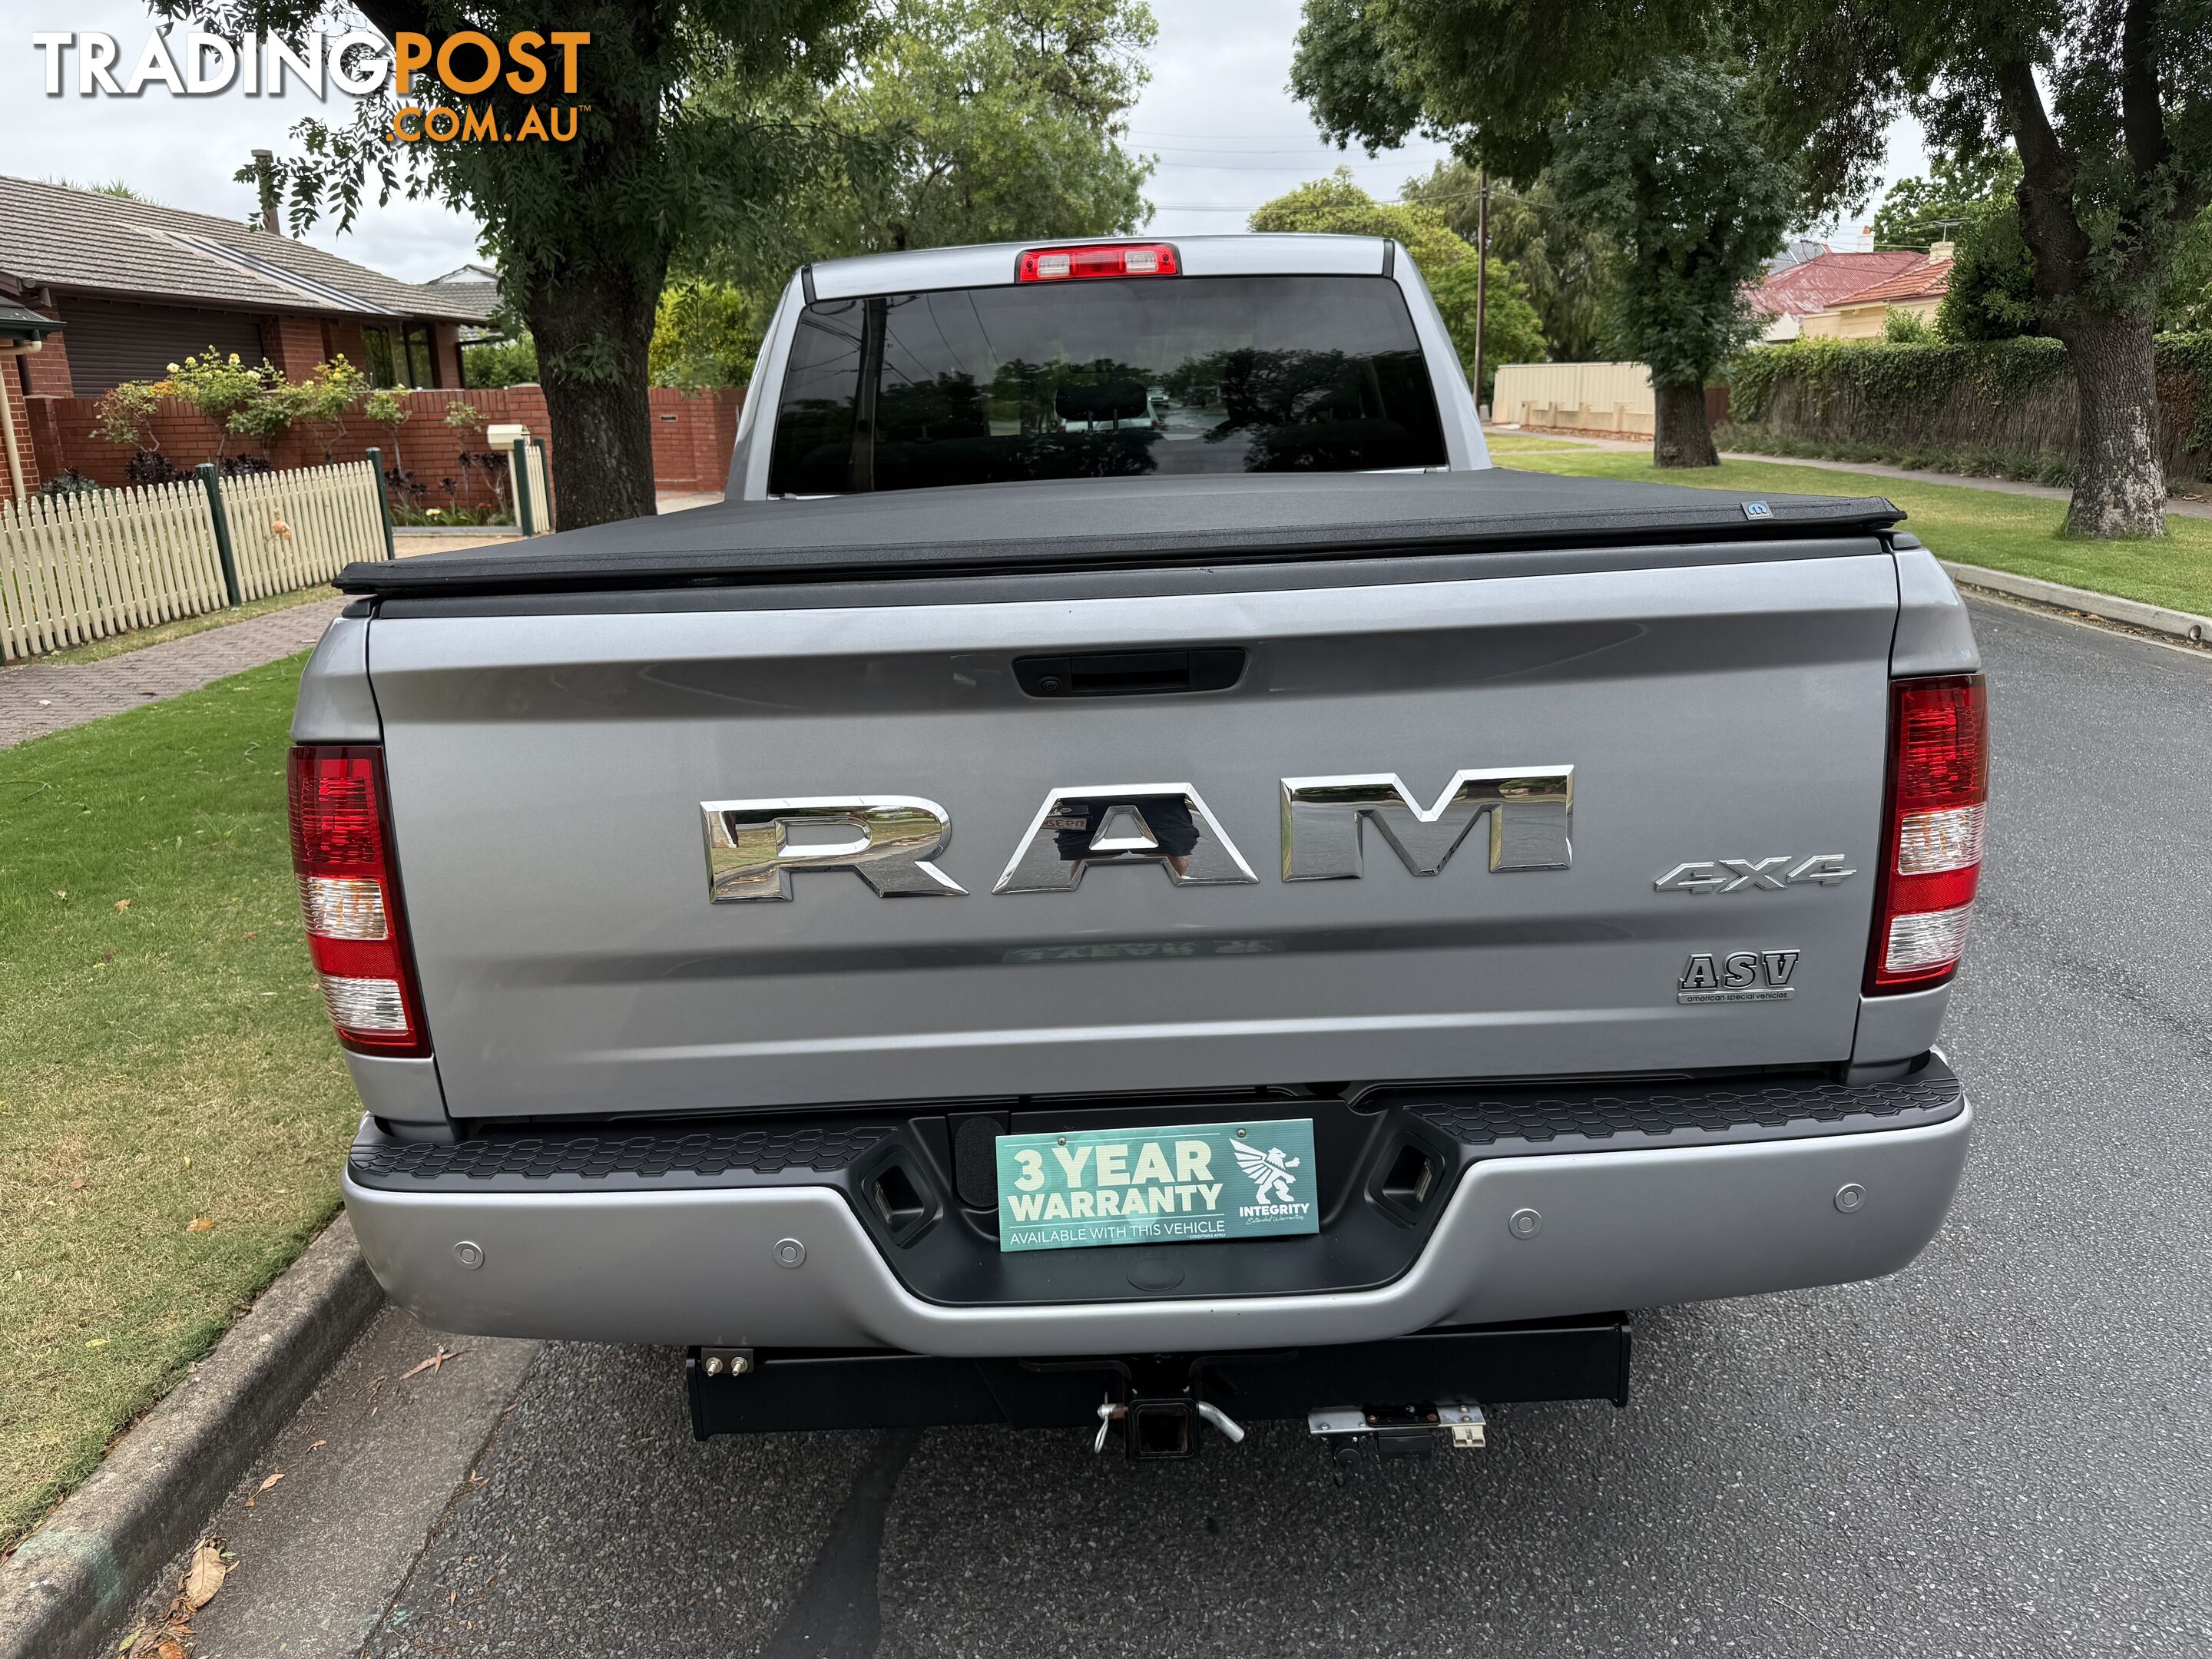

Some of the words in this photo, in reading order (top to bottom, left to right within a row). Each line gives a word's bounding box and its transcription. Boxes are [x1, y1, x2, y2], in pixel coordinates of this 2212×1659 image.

[700, 764, 1575, 905] RAM
[1677, 949, 1800, 991] ASV
[1727, 993, 1754, 1002] special
[1013, 1150, 1045, 1192] 3
[1051, 1140, 1215, 1188] YEAR
[1007, 1183, 1224, 1222] WARRANTY
[1239, 1203, 1310, 1217] INTEGRITY
[1010, 1227, 1088, 1245] AVAILABLE
[1090, 1225, 1127, 1240] WITH
[1131, 1223, 1161, 1237] THIS
[1166, 1220, 1225, 1235] VEHICLE
